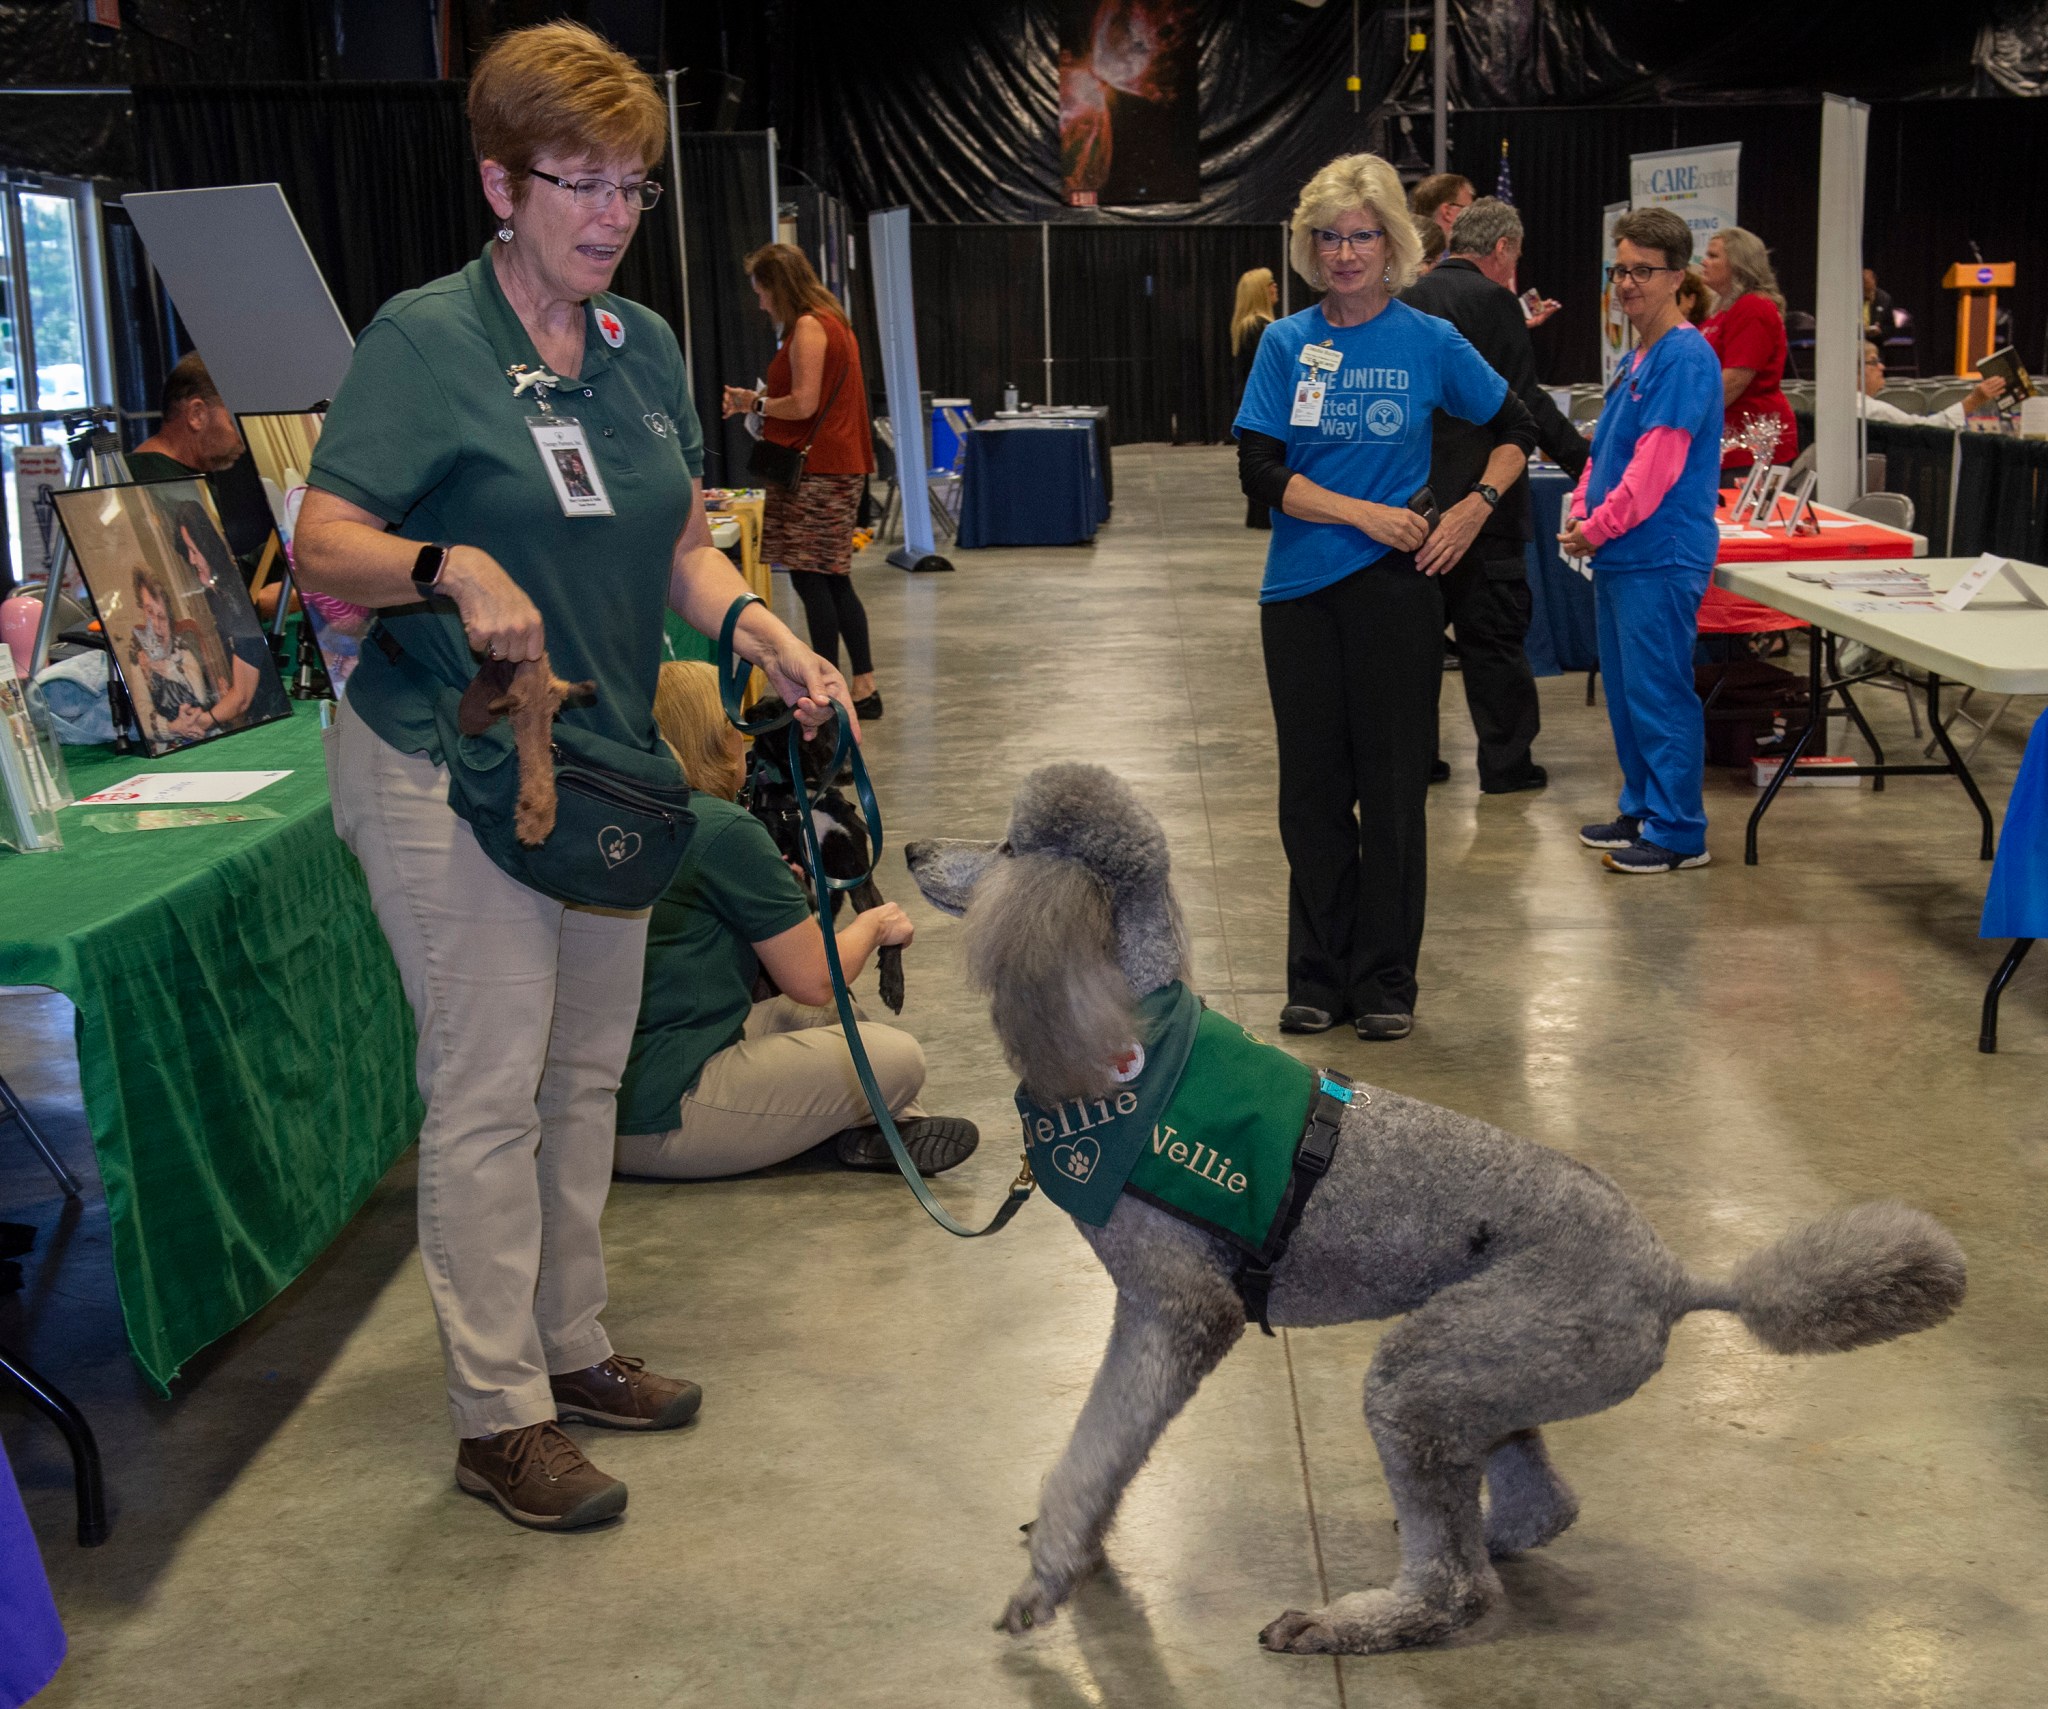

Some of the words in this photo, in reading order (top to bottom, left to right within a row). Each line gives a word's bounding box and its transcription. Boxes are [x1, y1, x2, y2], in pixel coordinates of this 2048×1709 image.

[1688, 217, 1719, 231] ERING
[1343, 367, 1410, 390] UNITED
[1322, 398, 1358, 416] ited
[1320, 418, 1357, 440] Way
[1152, 1122, 1247, 1194] Nellie
